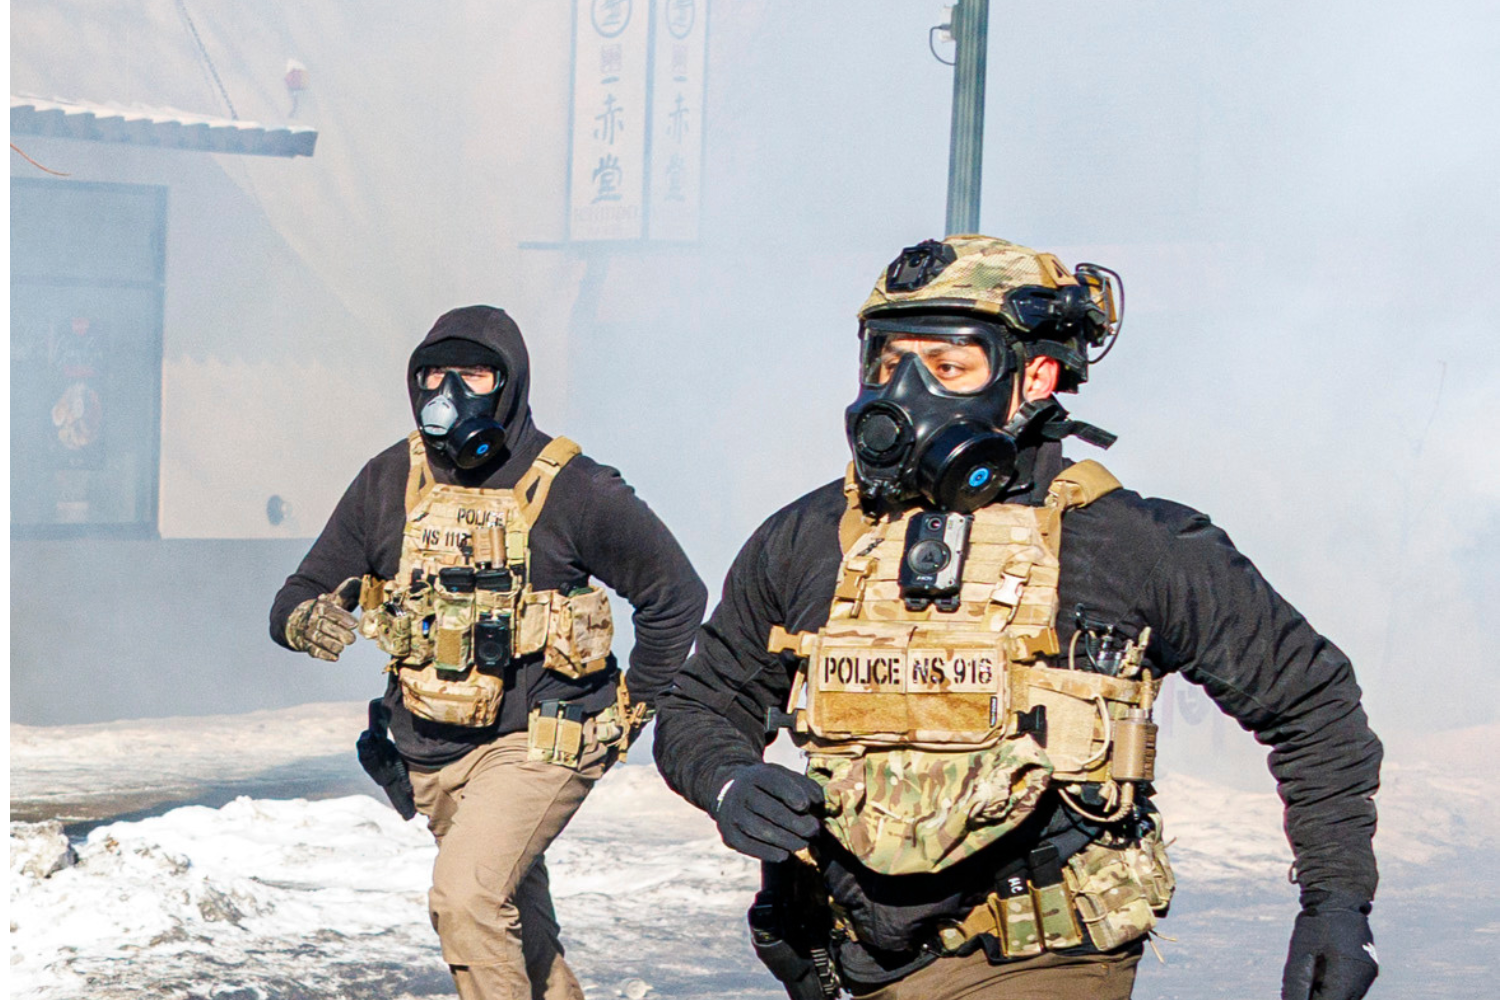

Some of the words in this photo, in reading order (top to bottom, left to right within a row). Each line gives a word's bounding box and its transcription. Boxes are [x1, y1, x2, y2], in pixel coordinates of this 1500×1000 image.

[457, 507, 506, 527] POLICE
[824, 656, 900, 685] POLICE
[912, 657, 947, 684] NS
